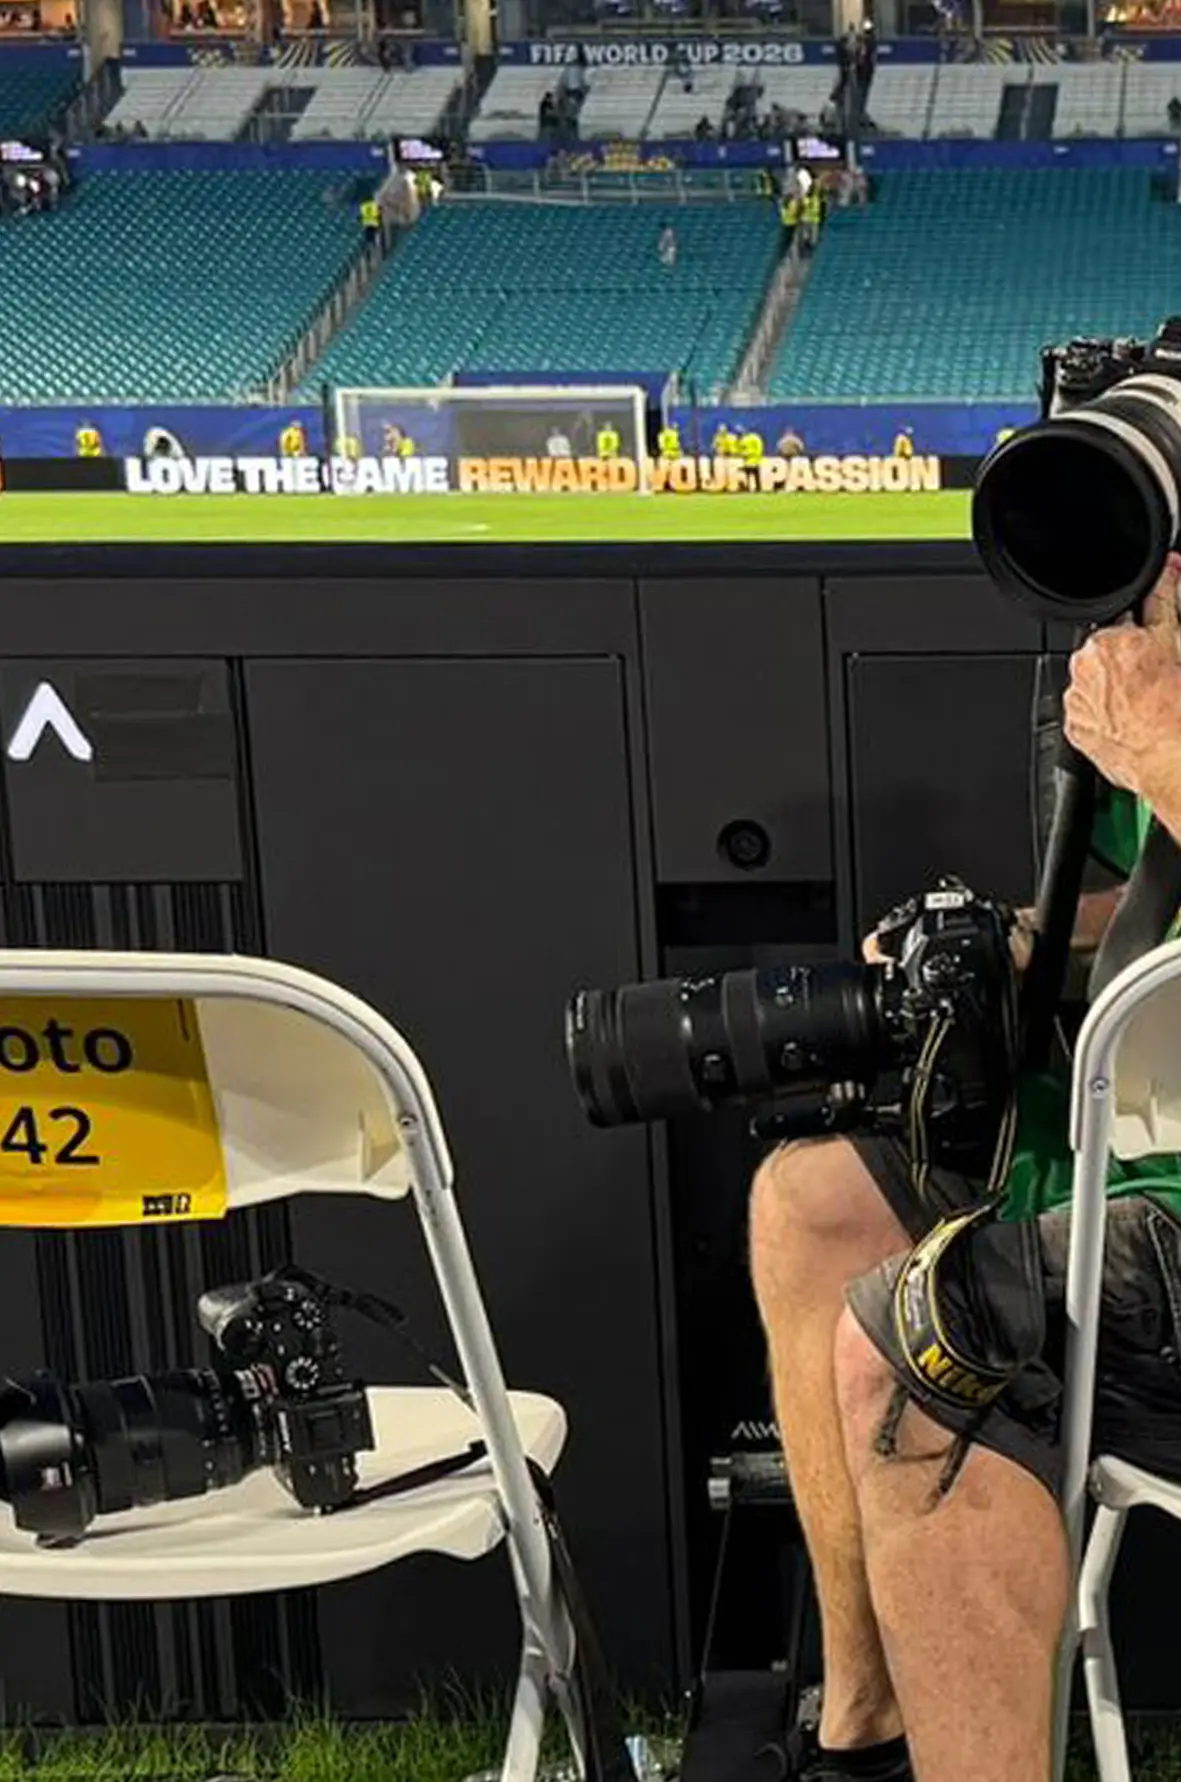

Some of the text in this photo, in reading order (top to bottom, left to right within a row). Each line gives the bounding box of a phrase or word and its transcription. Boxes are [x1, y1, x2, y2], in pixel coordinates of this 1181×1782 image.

[530, 43, 578, 63] FIFA
[584, 43, 668, 64] WORLD
[720, 43, 804, 63] 2026
[127, 456, 236, 492] LOVE
[237, 456, 320, 493] THE
[322, 456, 448, 493] GAME
[459, 456, 637, 490] REWARD
[760, 456, 939, 490] PASSION
[0, 1018, 133, 1073] oto
[0, 1106, 100, 1165] 42
